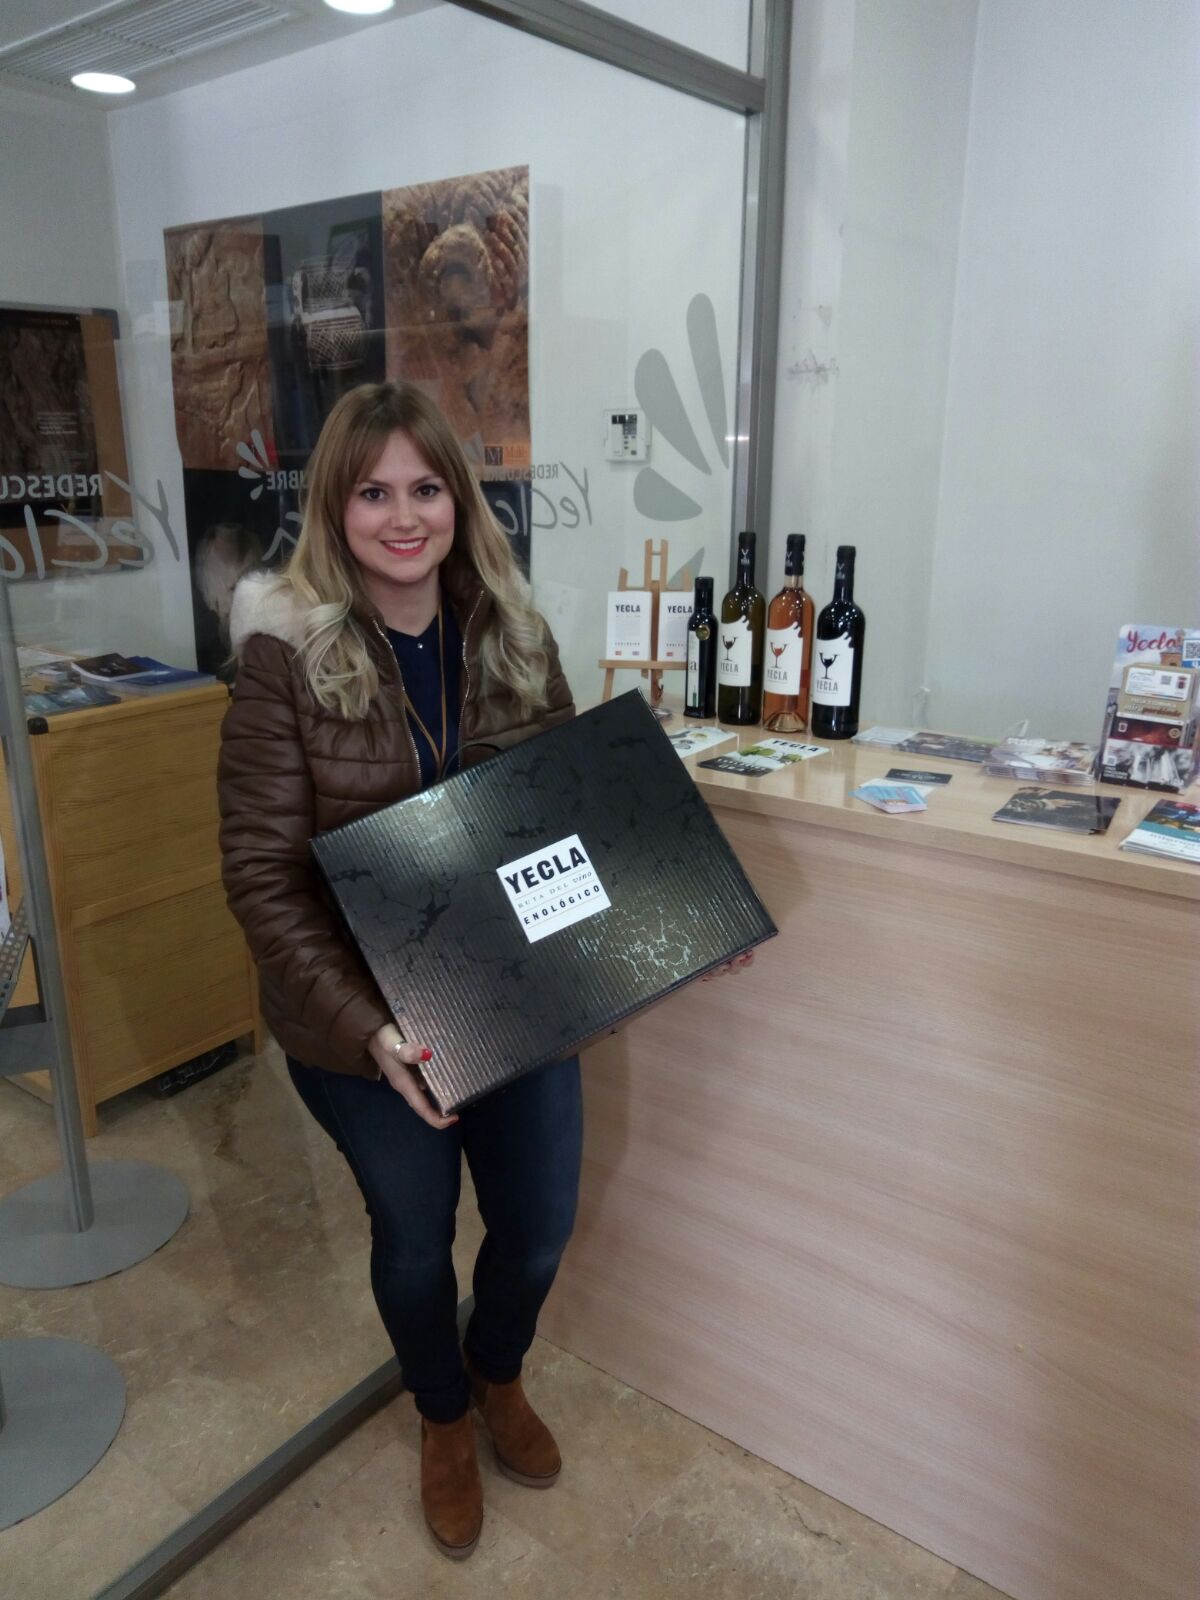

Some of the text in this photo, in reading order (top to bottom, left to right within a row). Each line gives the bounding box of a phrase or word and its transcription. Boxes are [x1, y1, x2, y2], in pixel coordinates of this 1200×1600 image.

[615, 604, 641, 613] YECLA
[667, 605, 693, 614] YECLA
[767, 668, 788, 681] YECLA
[816, 679, 839, 692] YECLA
[504, 846, 587, 894] YECLA
[523, 884, 600, 925] ENOLÓGICO
